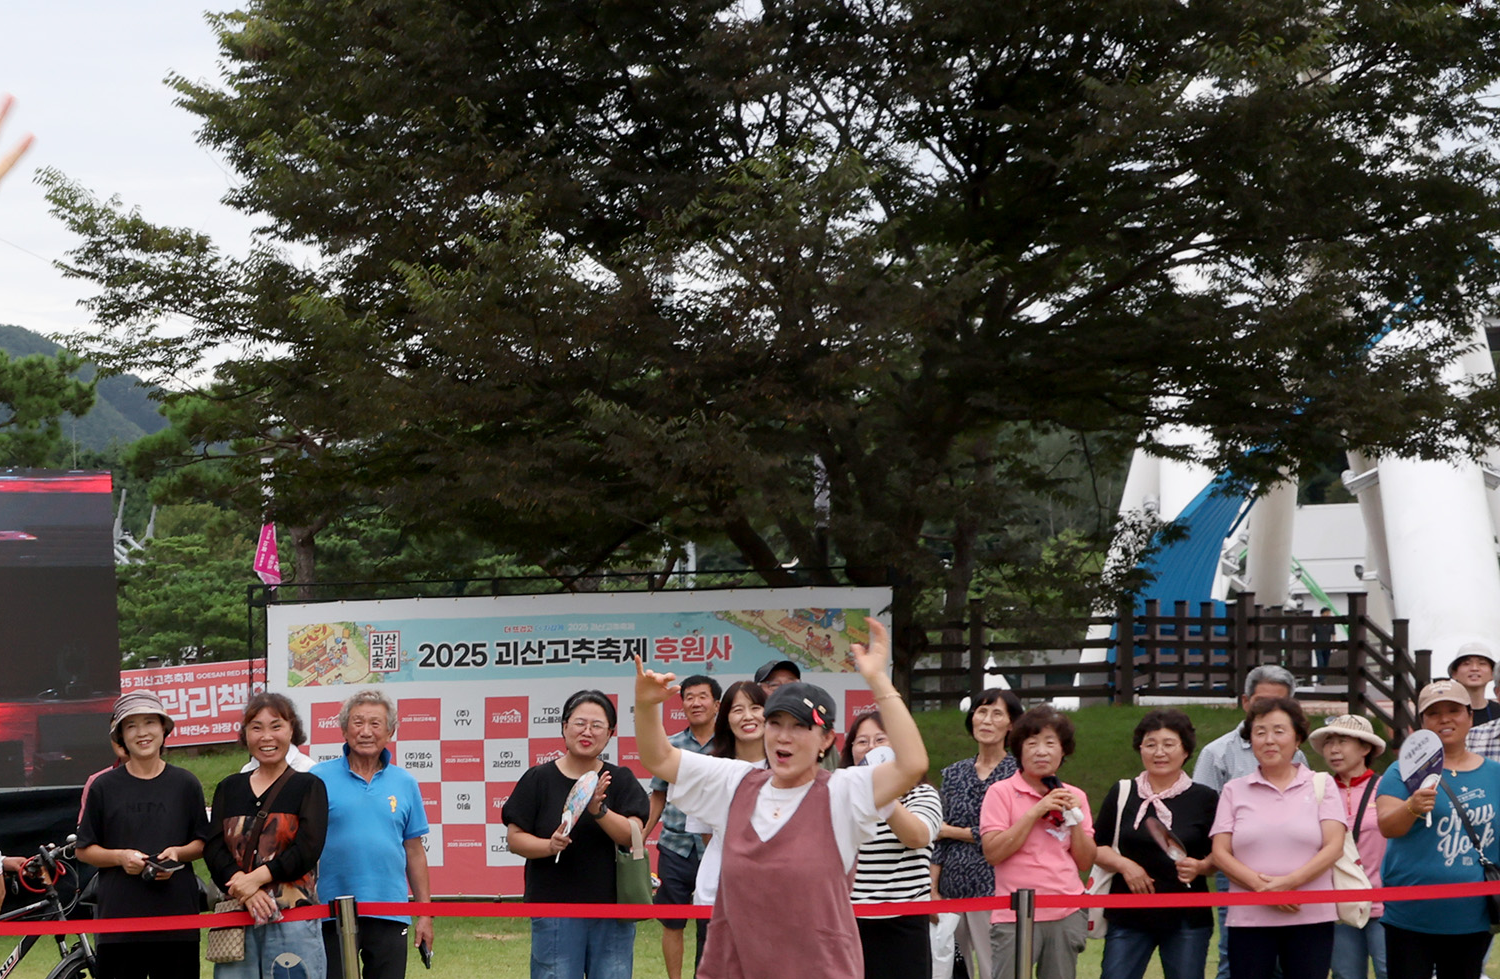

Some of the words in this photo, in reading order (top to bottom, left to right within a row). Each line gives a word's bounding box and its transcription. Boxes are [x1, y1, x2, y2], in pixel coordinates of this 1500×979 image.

[372, 633, 397, 646] 괴산
[372, 645, 397, 658] 고추
[418, 642, 488, 668] 2025
[495, 637, 647, 666] 괴산고추축제
[654, 635, 733, 663] 후원사
[372, 656, 397, 670] 축제
[134, 672, 194, 687] 괴산고추축제
[196, 671, 226, 680] GOESAN
[227, 669, 241, 678] RED
[456, 709, 469, 717] (주)
[542, 707, 560, 715] TDS
[533, 716, 562, 724] 디스플레
[180, 724, 210, 736] 박진수
[211, 722, 232, 733] 과장
[405, 761, 433, 769] 전력공사
[457, 793, 470, 801] (주)
[1437, 822, 1495, 867] Yok
